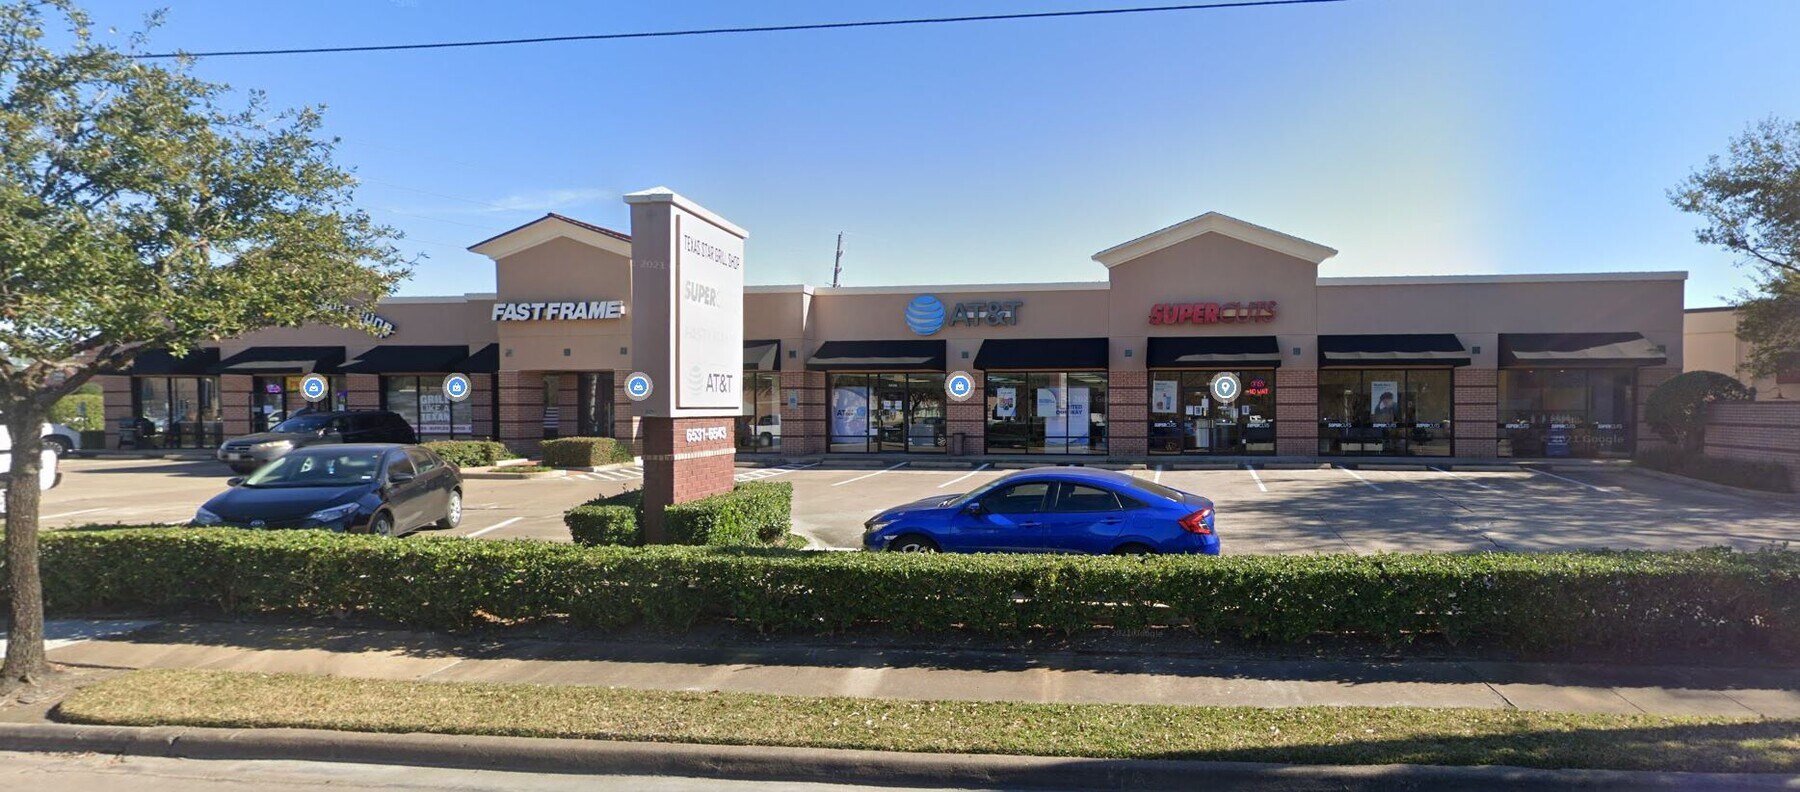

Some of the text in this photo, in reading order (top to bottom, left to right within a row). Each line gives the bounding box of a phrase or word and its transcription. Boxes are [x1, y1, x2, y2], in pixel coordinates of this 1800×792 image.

[684, 234, 740, 270] TEXAS STAR GRILL SHOP
[949, 301, 1024, 327] AT&T
[1149, 300, 1278, 326] SUPERCUTS
[706, 373, 733, 393] AT&T
[420, 395, 450, 404] GRILL
[421, 404, 450, 412] LIKE A
[420, 413, 450, 421] TEXAN
[686, 427, 727, 442] 6531-6543
